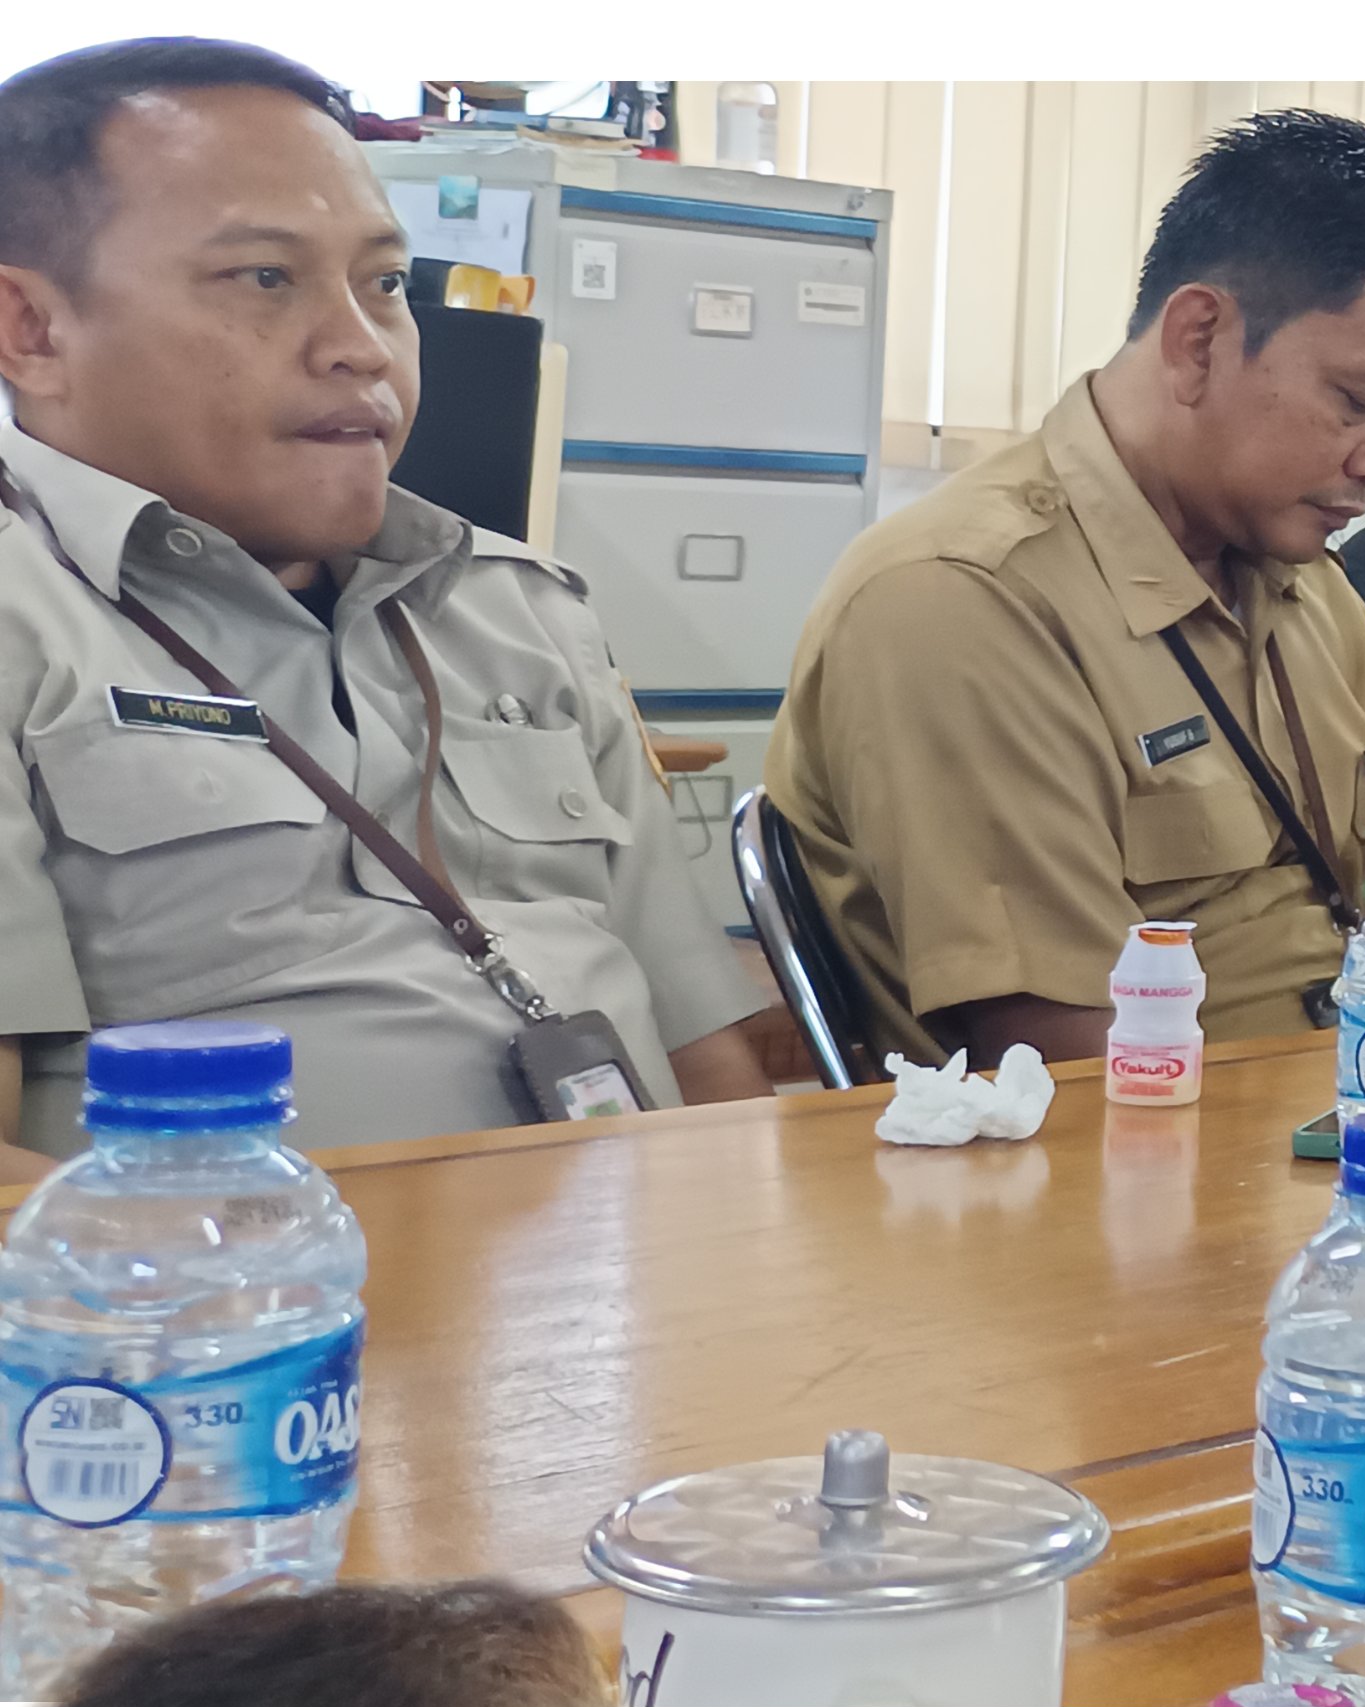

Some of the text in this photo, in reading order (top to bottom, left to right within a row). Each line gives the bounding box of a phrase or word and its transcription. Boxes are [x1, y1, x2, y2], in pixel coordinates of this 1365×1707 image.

[1139, 985, 1193, 999] MANGGA
[1118, 1060, 1176, 1076] Yakult
[183, 1400, 243, 1429] 330
[1301, 1474, 1346, 1503] 330
